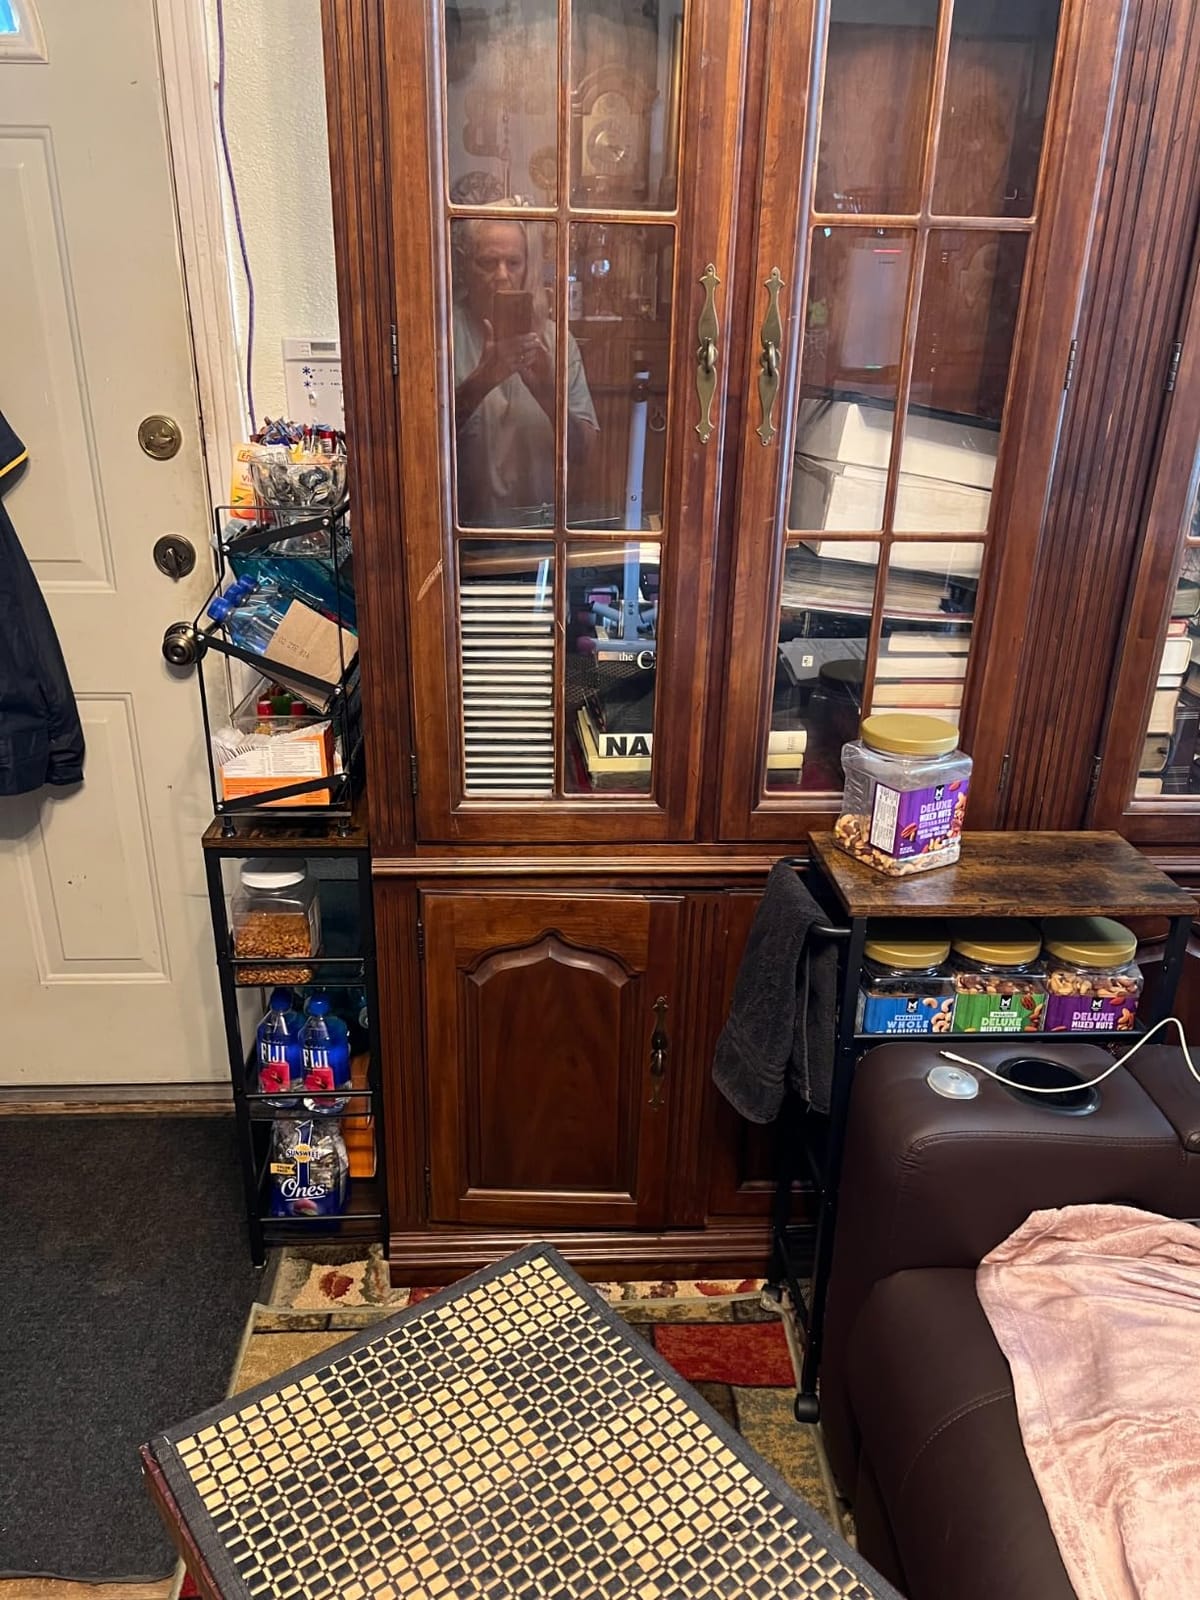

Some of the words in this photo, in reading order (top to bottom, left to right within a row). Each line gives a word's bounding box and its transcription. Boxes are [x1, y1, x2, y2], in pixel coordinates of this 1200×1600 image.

[619, 652, 633, 661] the
[636, 650, 656, 669] C
[606, 736, 650, 756] NA
[920, 800, 952, 814] DELUXE
[919, 812, 937, 822] MIXED
[937, 809, 951, 819] NUTS
[981, 1017, 1022, 1026] DELUXE
[1072, 1012, 1115, 1022] DELUXE
[887, 1020, 929, 1029] WHOLE
[1071, 1021, 1094, 1029] MIXED
[261, 1042, 287, 1063] FIJI
[302, 1048, 329, 1068] FIJI
[286, 1149, 320, 1159] SUNSWEET
[281, 1178, 326, 1197] Ones
